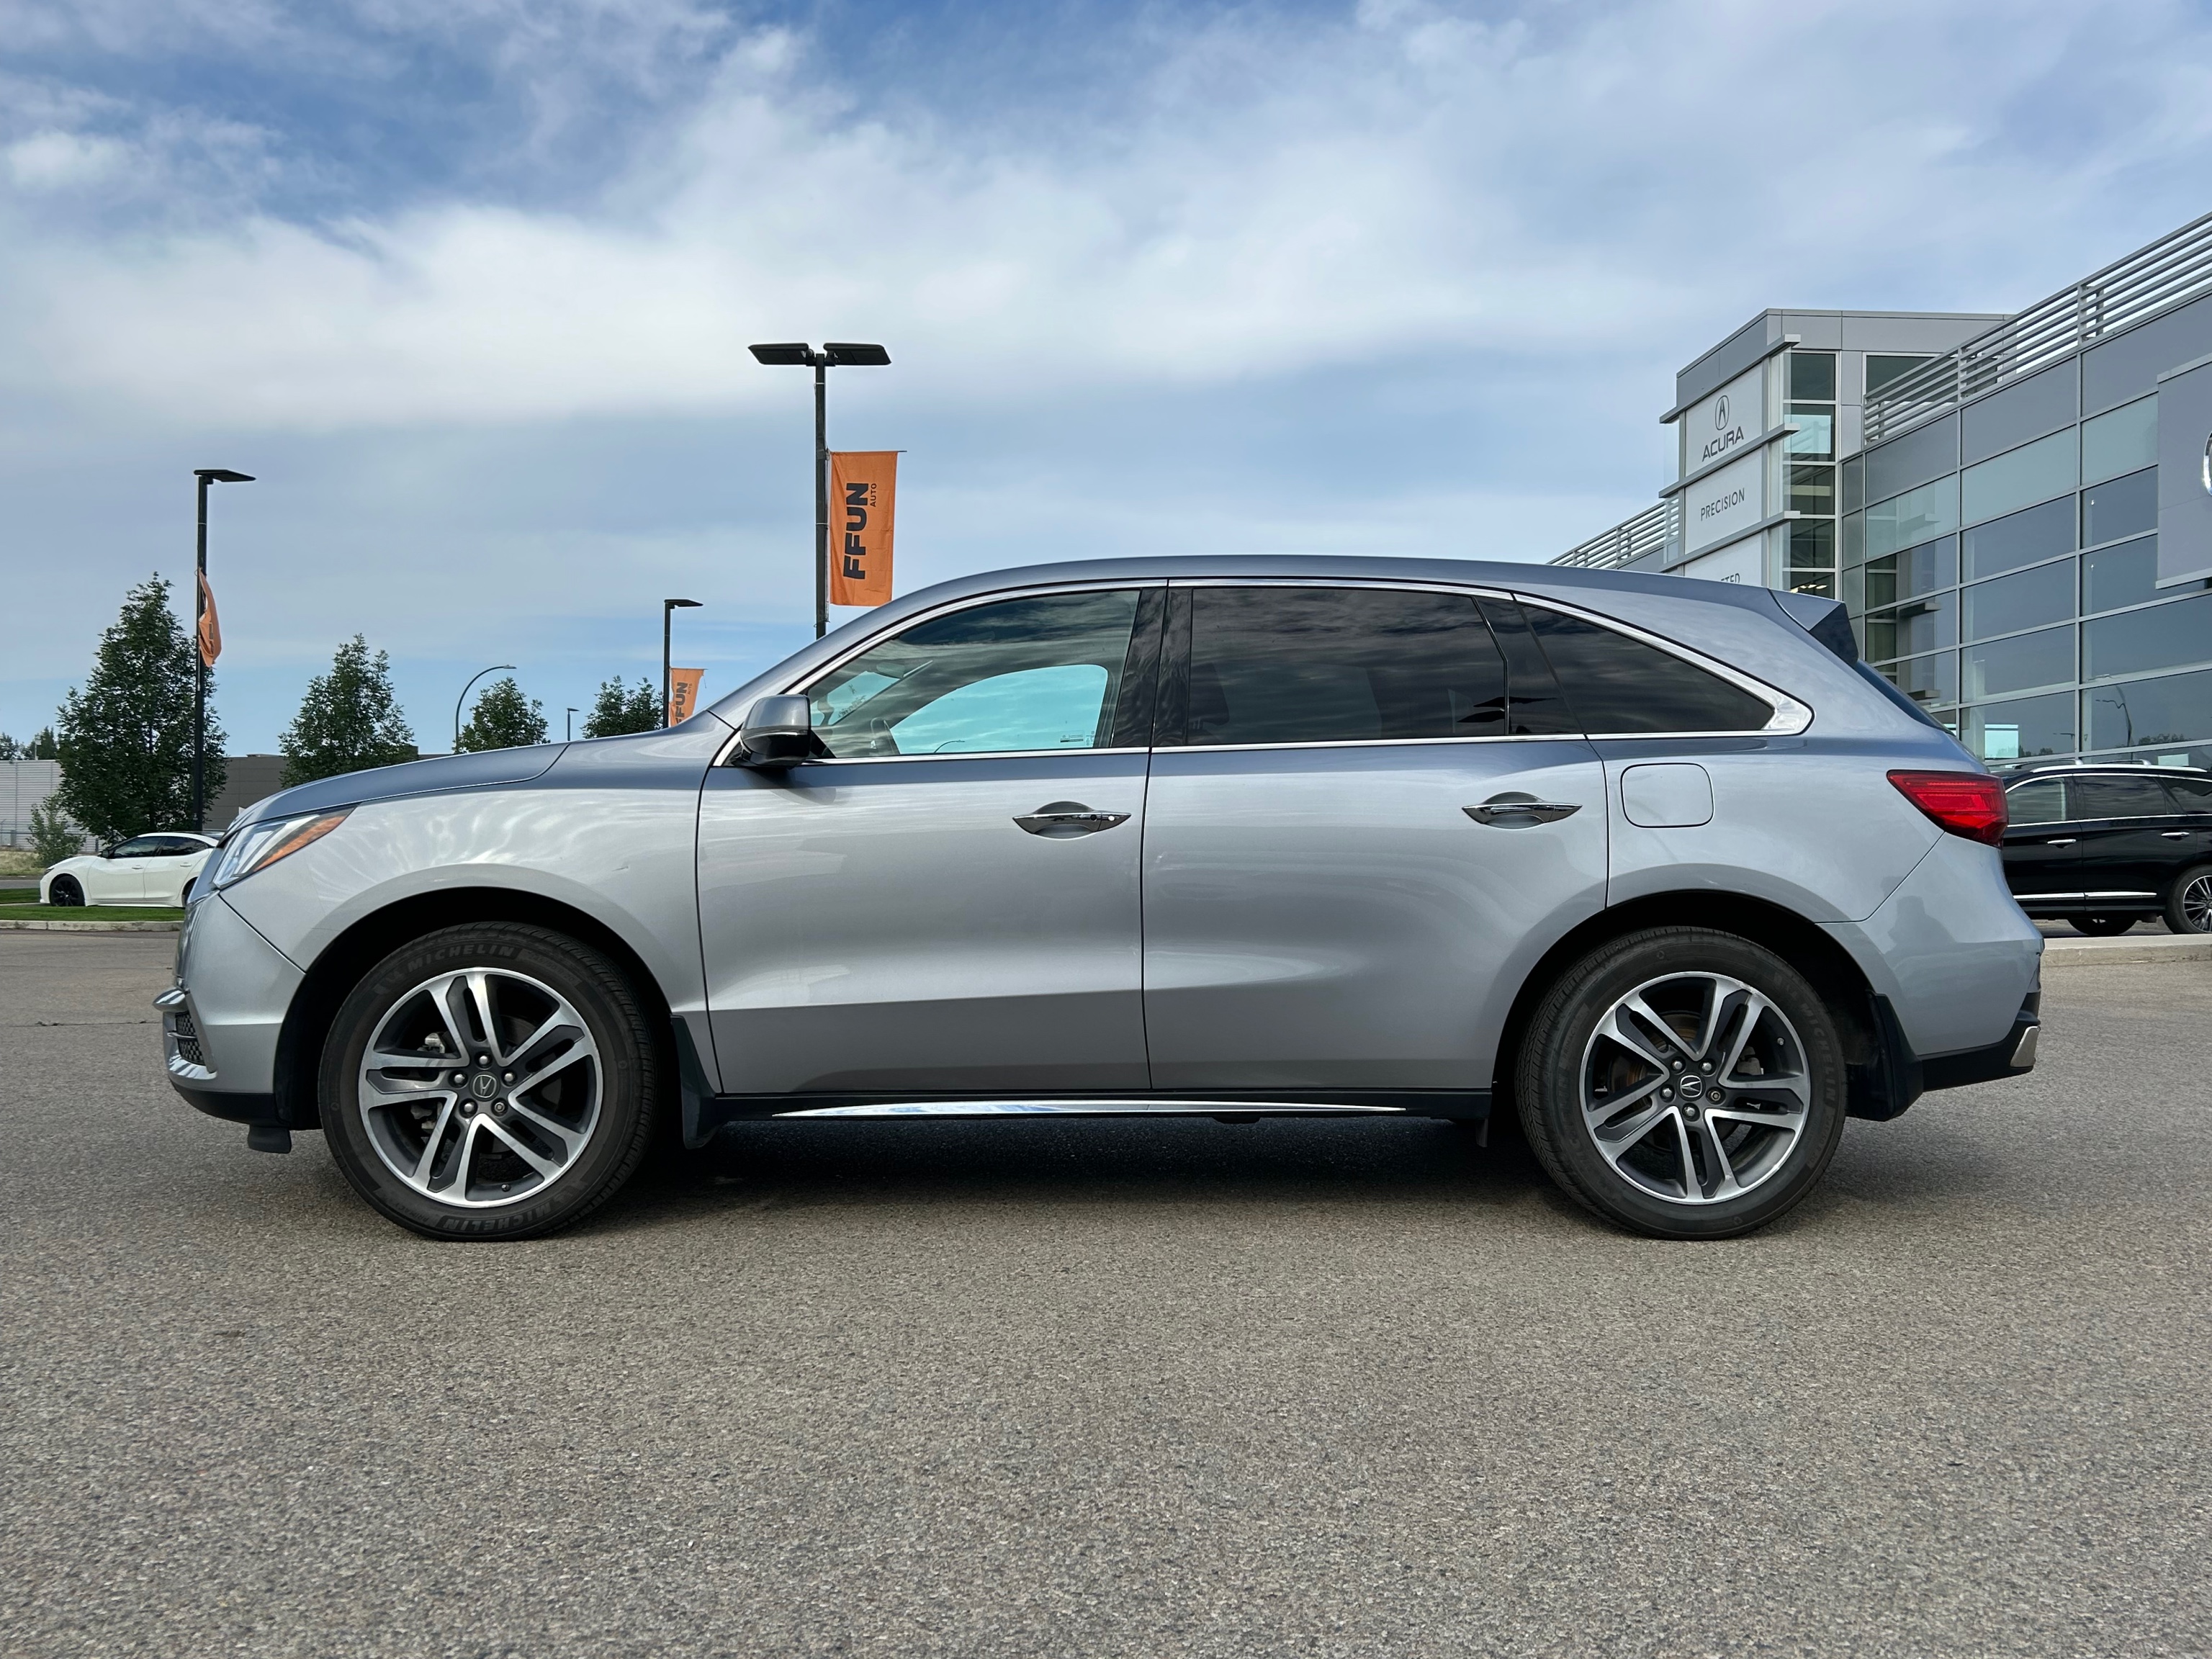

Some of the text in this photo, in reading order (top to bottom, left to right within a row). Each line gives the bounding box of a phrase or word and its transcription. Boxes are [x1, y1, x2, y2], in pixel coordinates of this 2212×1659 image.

[1701, 426, 1745, 462] ACURA
[1700, 487, 1745, 522] PRECISION
[842, 482, 869, 580] FFUN
[406, 943, 516, 974] MICHELIN
[1799, 1002, 1835, 1102] MICHELIN
[394, 1202, 430, 1223] PRIMACY
[442, 1201, 553, 1231] MICHELIN
